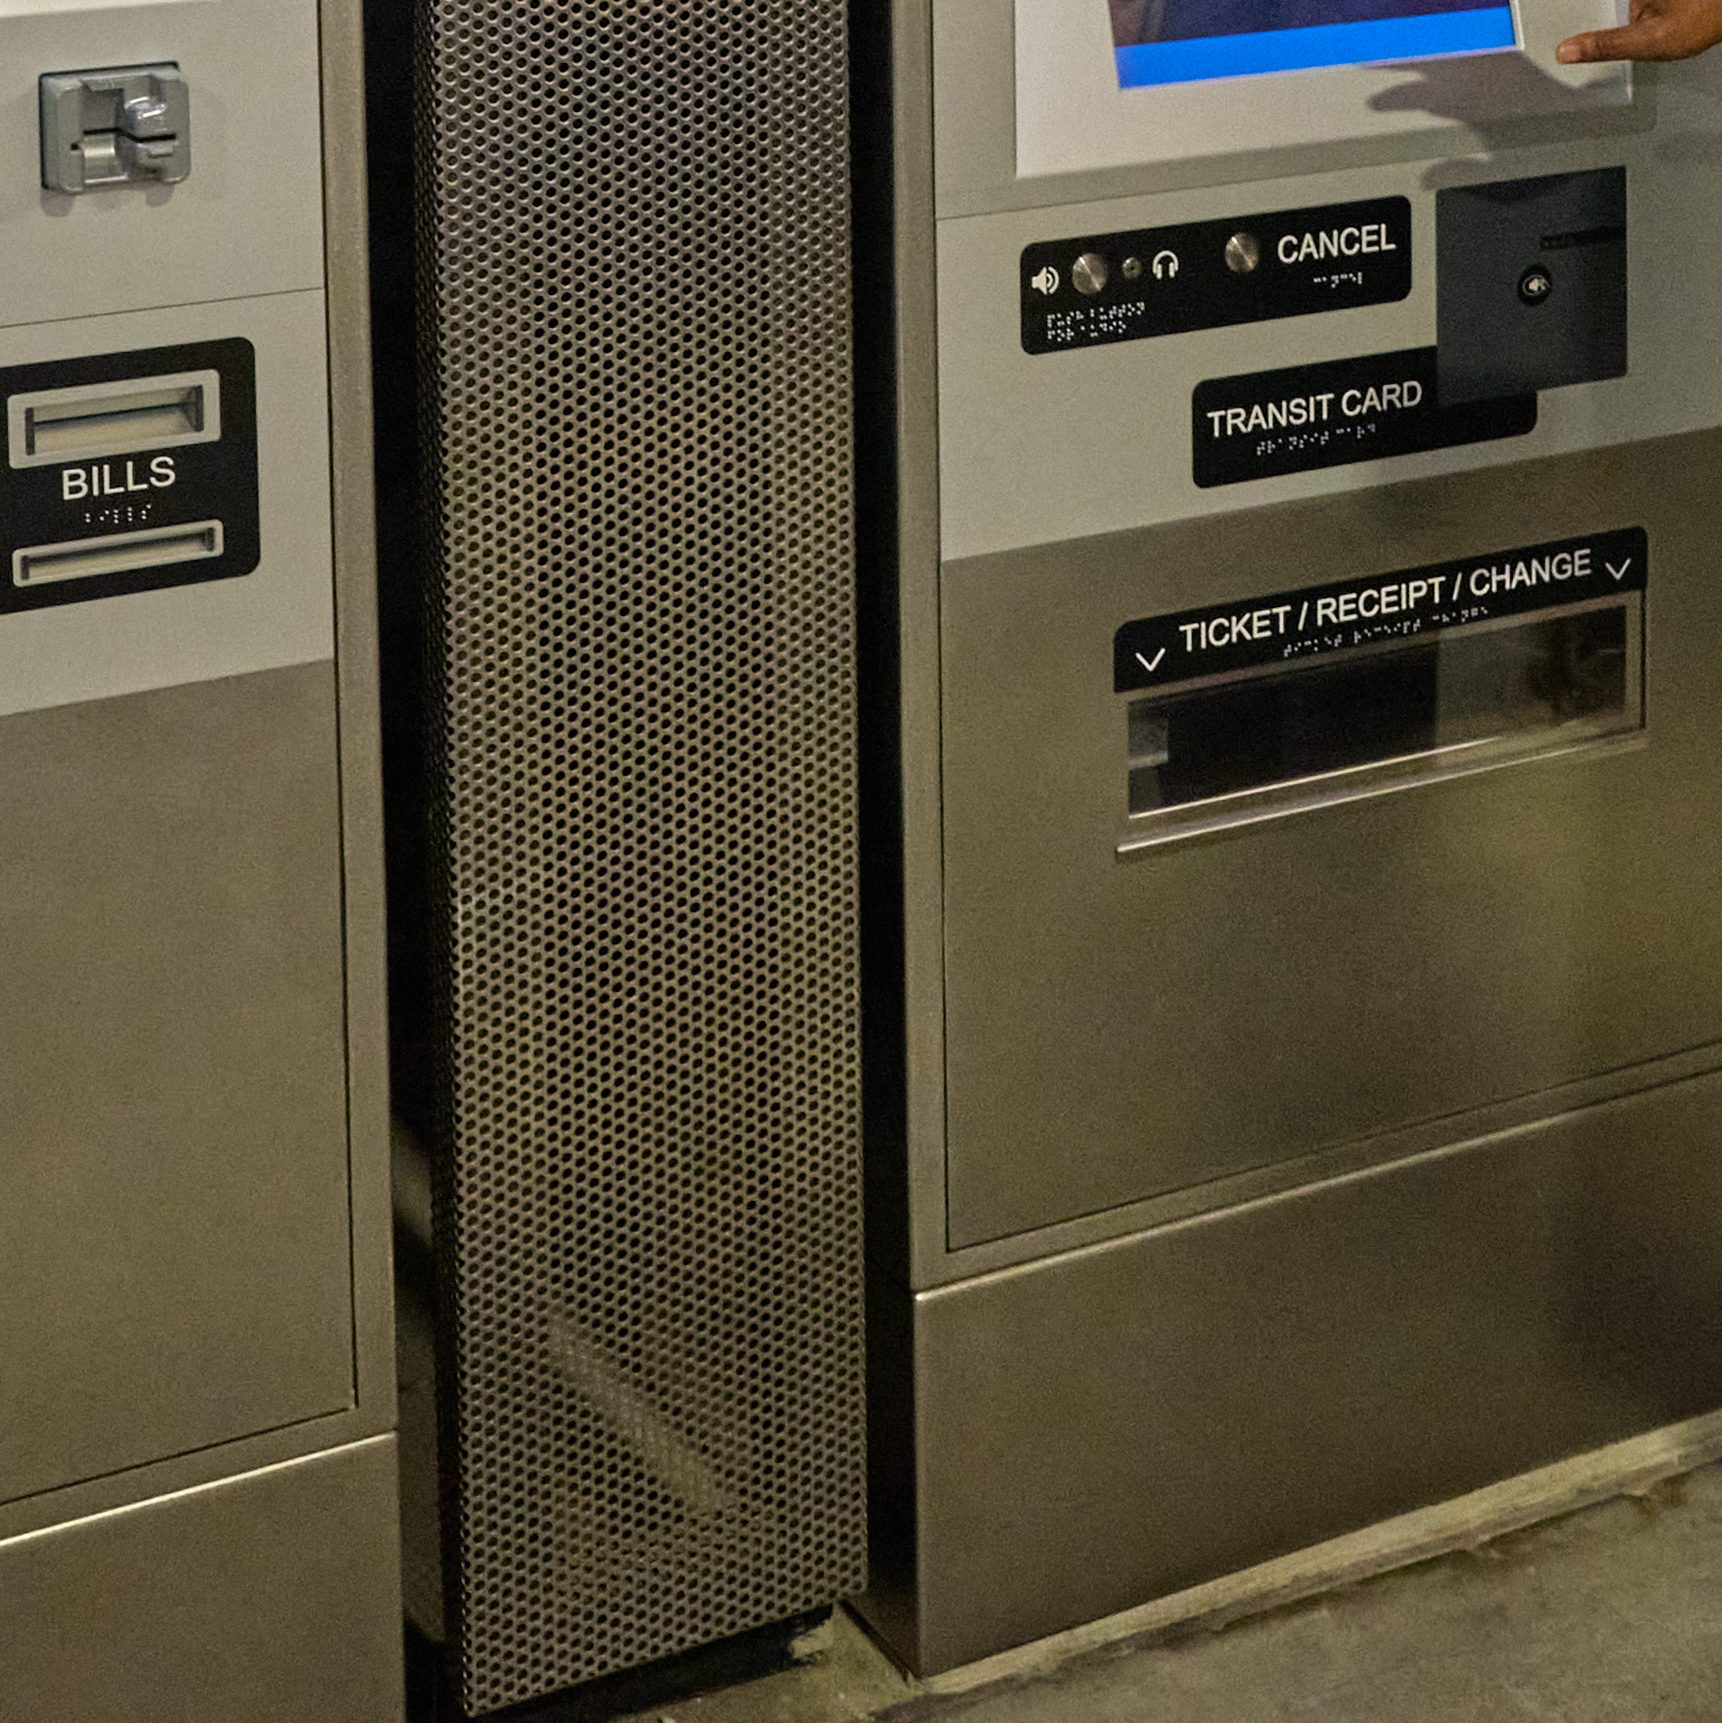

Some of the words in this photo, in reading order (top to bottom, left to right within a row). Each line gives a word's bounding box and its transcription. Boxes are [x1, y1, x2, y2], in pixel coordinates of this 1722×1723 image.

[1277, 223, 1397, 264] CANCEL
[1207, 392, 1335, 438] TRANSIT
[1341, 380, 1423, 417] CARD
[61, 451, 176, 500] BILLS
[1179, 604, 1292, 654] TICKET
[1297, 601, 1309, 631] /
[1316, 576, 1447, 628] RECEIPT
[1453, 572, 1463, 601] /
[1469, 548, 1593, 596] CHANGE
